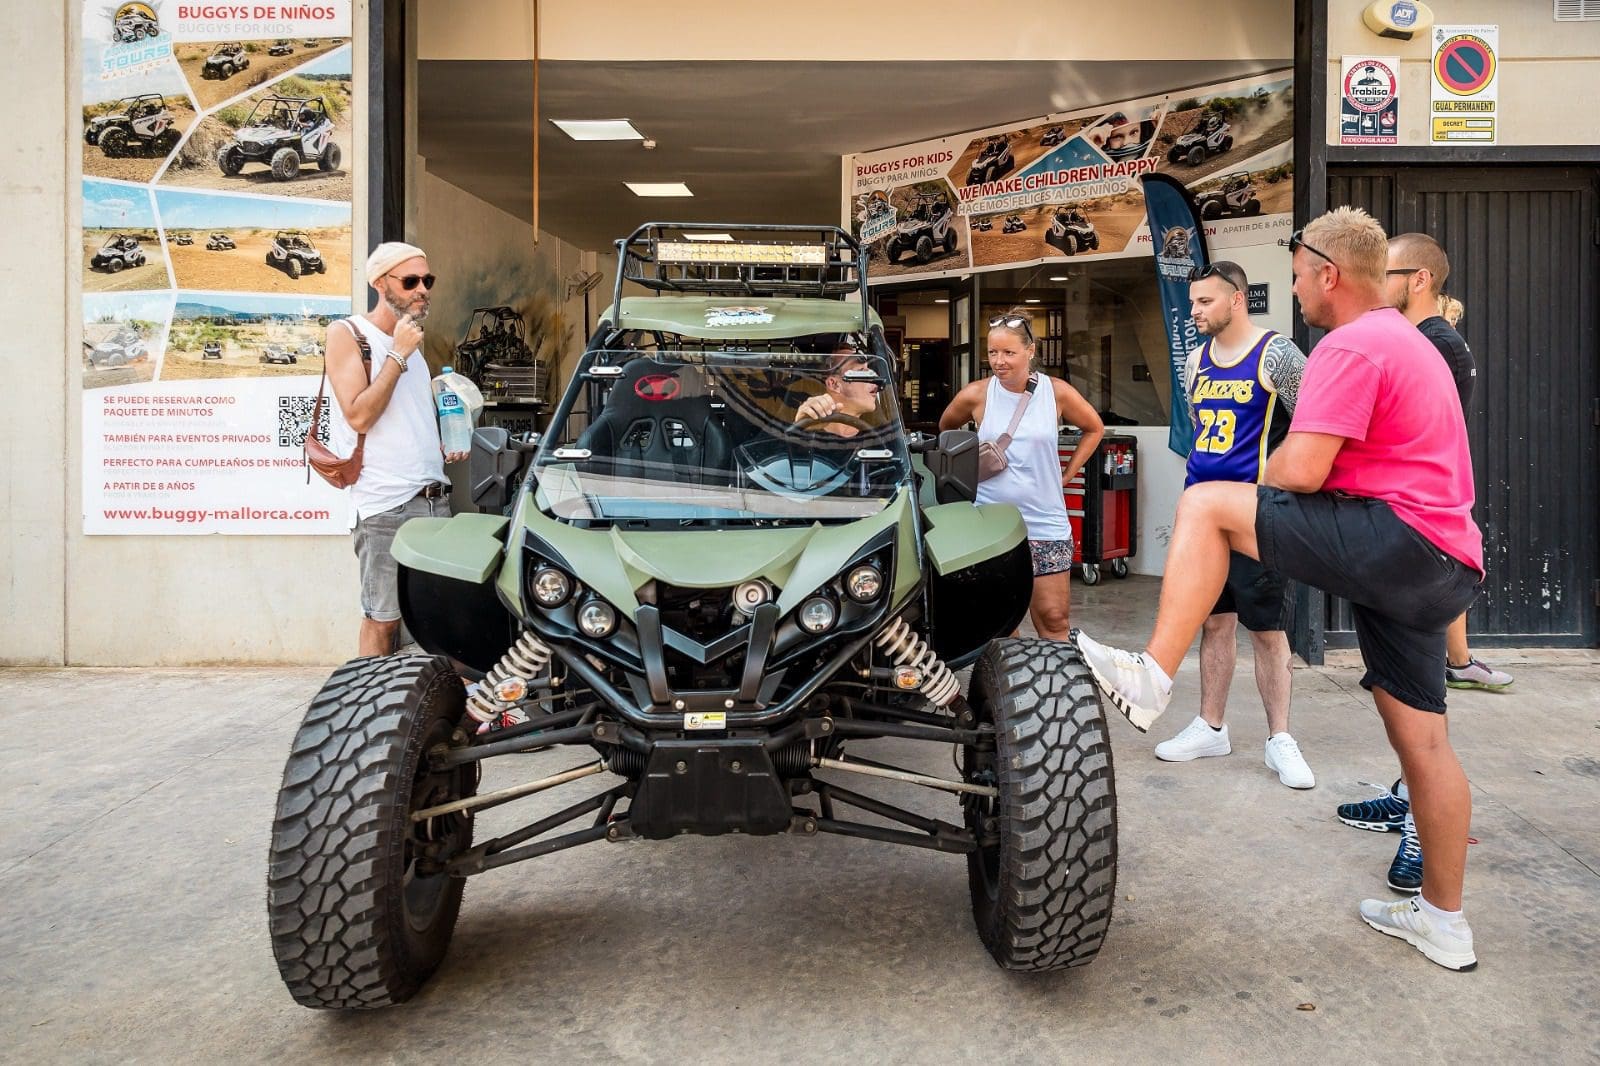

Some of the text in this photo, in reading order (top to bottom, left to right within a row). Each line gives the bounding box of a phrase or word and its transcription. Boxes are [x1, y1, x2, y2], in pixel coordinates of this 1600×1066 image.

[178, 4, 336, 19] BUGGYS DE NIÑOS
[178, 23, 294, 34] BUGGYS FOR KIDS
[103, 44, 170, 69] TOURS
[1351, 87, 1388, 96] Trablisa
[1454, 102, 1493, 111] PERMANENT
[1343, 136, 1396, 144] VIDEOVIGILANCIA
[857, 151, 953, 176] BUGGYS FOR KIDS
[857, 167, 938, 188] BUGGY PARA NIÑOS
[959, 157, 1159, 201] WE MAKE CHILDREN HAPPY
[958, 180, 1128, 214] HACEMOS FELICES A LOS NIÑOS
[863, 217, 896, 238] TOURS
[1252, 222, 1264, 231] DE
[1272, 218, 1292, 228] AÑO
[1137, 234, 1153, 243] FRO
[1192, 375, 1255, 404] LAKERS
[103, 396, 236, 404] SE PUEDE RESERVAR COMO
[103, 408, 214, 418] PAQUETE DE MINUTOS
[103, 433, 271, 443] TAMBIÉN PARA EVENTOS PRIVADOS
[1196, 409, 1237, 454] 23
[103, 457, 305, 467] PERFECTO PARA CUMPLEAÑOS DE NIÑOS
[103, 481, 195, 491] A PATIR DE 8 AÑOS
[104, 507, 330, 522] www.buggy-mallorca.com
